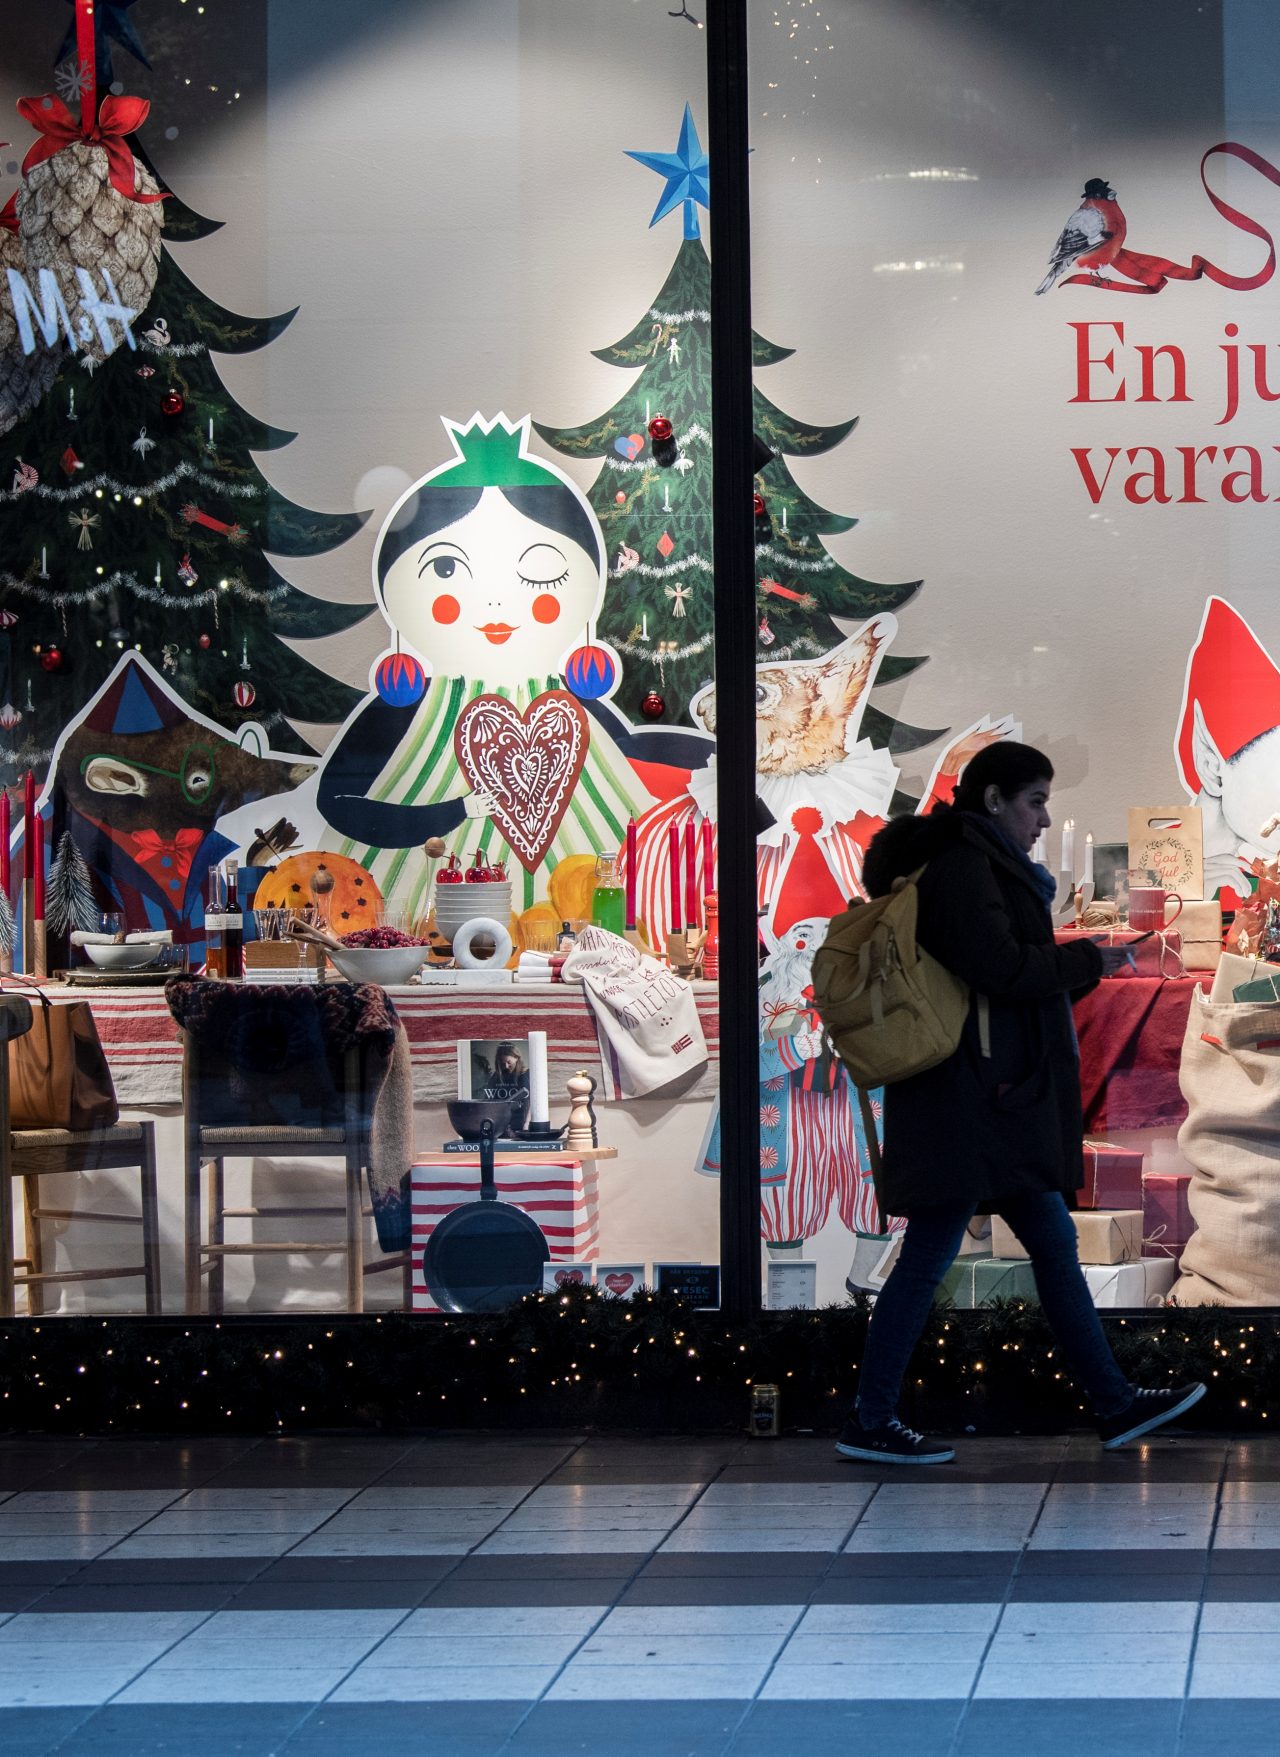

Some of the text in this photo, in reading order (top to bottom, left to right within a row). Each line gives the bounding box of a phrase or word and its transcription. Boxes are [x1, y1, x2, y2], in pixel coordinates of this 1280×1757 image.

[1065, 320, 1195, 403] En
[1153, 851, 1178, 868] God
[457, 1144, 481, 1152] WOO
